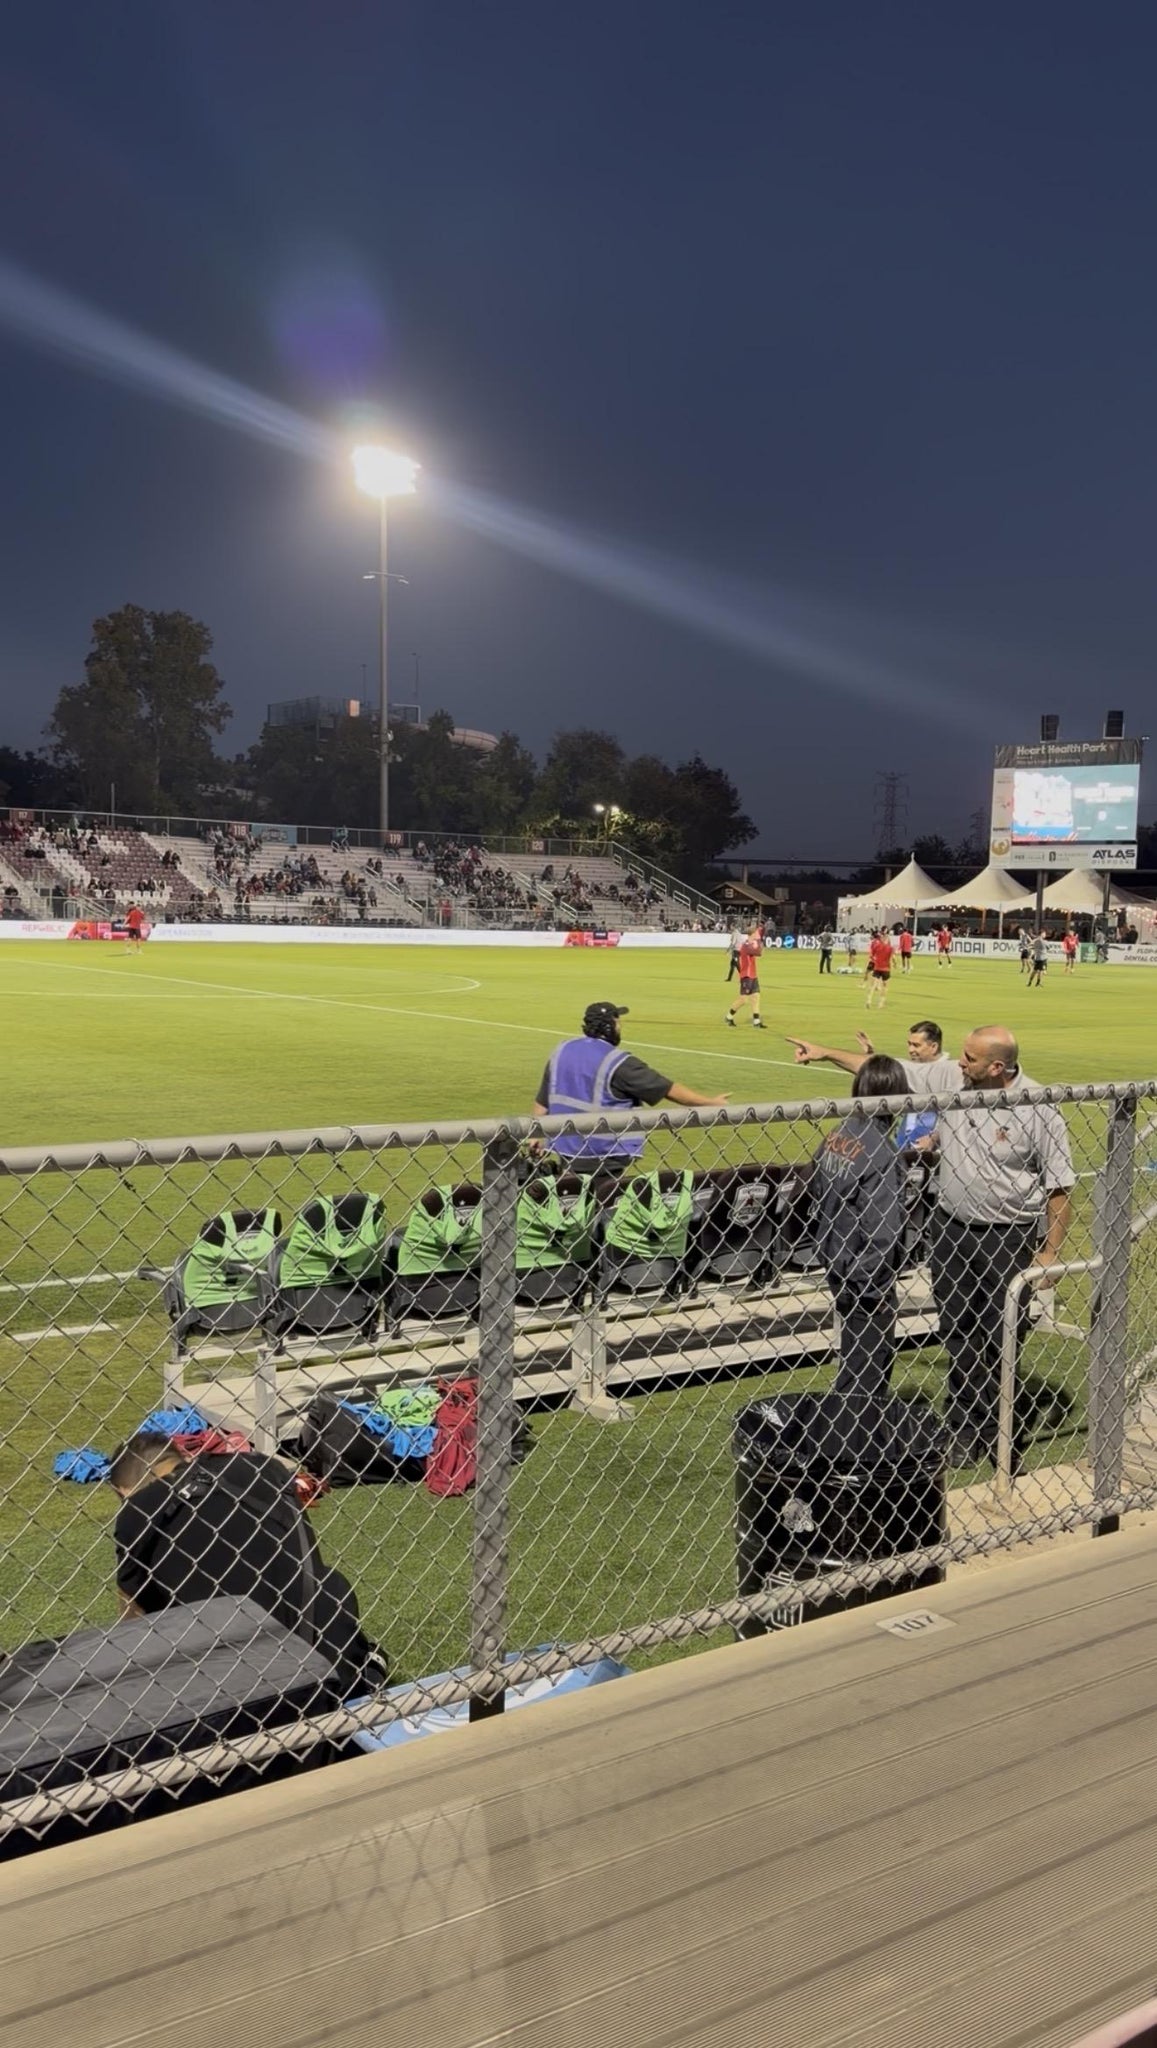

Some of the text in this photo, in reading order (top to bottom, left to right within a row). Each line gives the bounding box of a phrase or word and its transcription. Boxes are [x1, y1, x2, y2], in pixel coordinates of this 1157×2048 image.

[1016, 742, 1107, 756] Heart Health Park
[234, 825, 247, 836] 118
[390, 833, 402, 845] 119
[531, 840, 545, 851] 120
[1092, 849, 1136, 859] ATLAS
[765, 936, 783, 948] 0-0
[894, 1614, 934, 1633] 107
